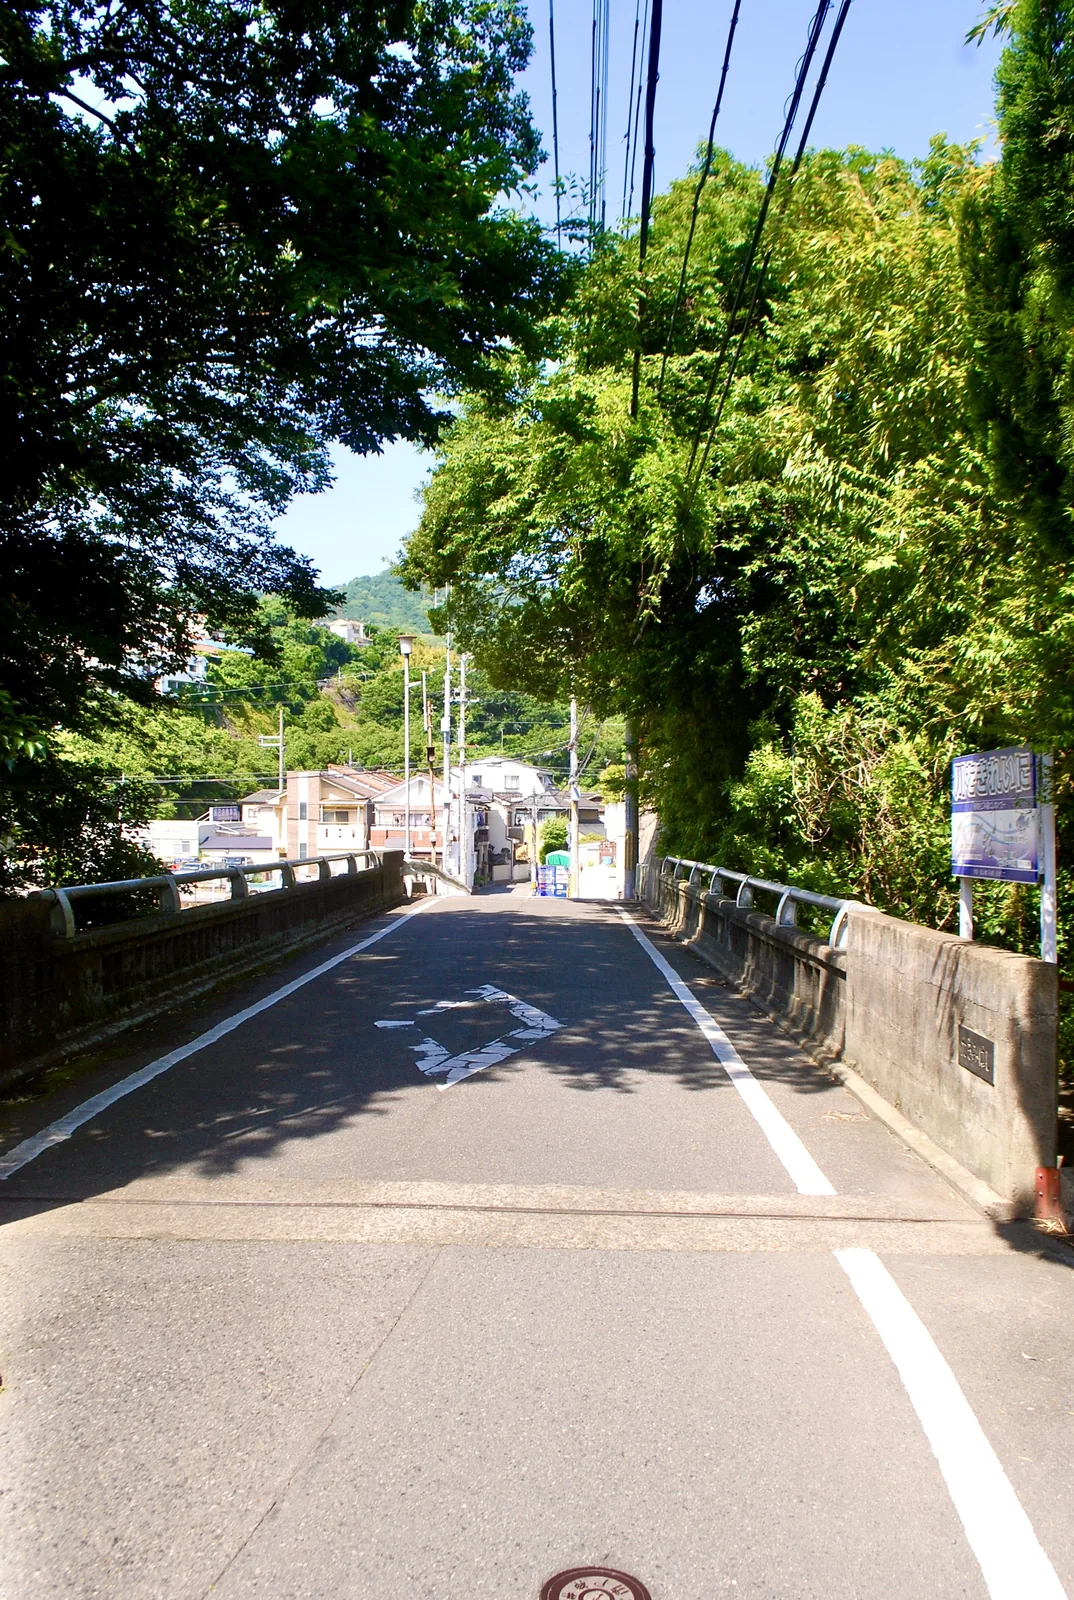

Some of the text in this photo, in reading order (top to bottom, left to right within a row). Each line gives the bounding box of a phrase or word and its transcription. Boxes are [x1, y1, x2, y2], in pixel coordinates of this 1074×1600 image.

[953, 752, 1031, 801] 川をきれいに
